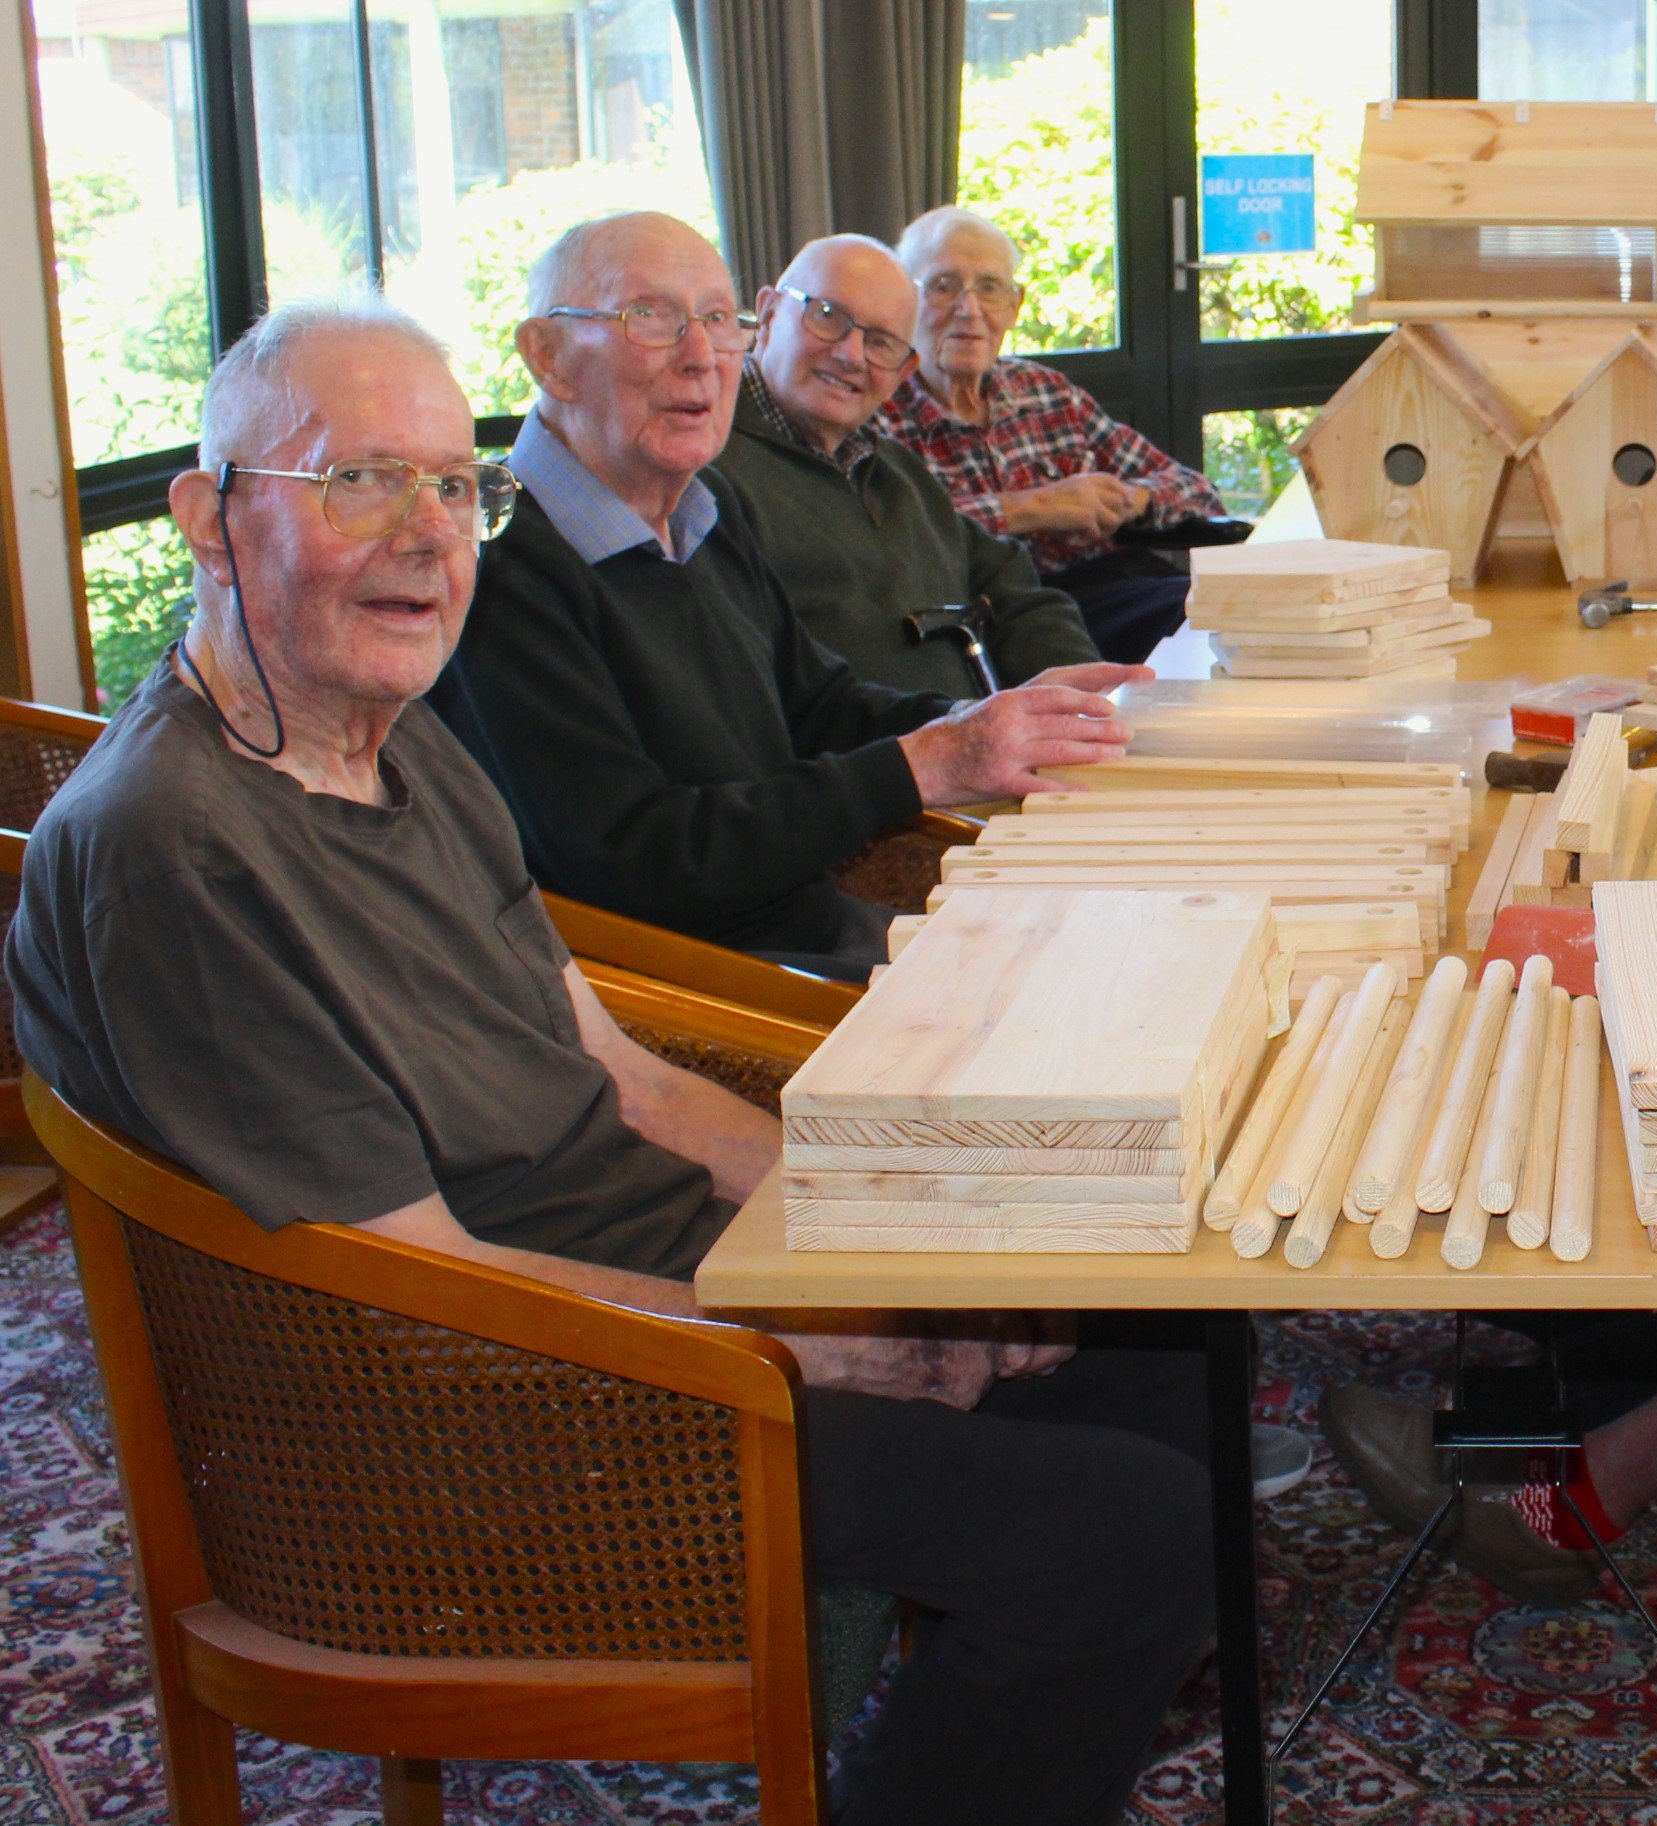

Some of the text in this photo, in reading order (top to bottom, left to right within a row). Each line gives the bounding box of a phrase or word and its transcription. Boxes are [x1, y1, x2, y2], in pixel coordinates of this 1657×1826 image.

[1205, 177, 1313, 195] SELF LOCKING
[1238, 197, 1283, 213] DOOR
